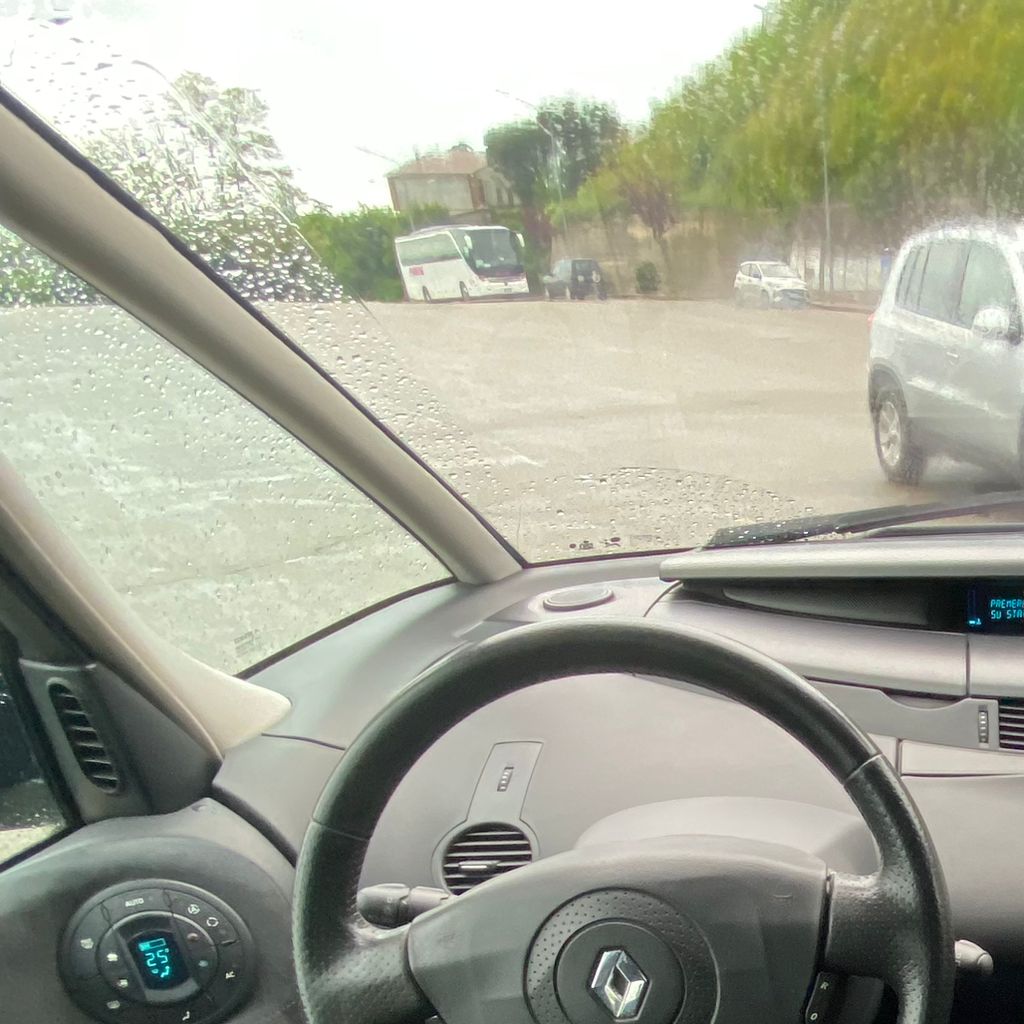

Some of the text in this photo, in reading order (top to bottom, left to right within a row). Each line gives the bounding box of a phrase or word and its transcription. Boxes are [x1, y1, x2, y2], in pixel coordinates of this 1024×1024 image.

[990, 609, 1002, 620] SU
[125, 898, 145, 907] AUTO
[820, 981, 829, 990] R
